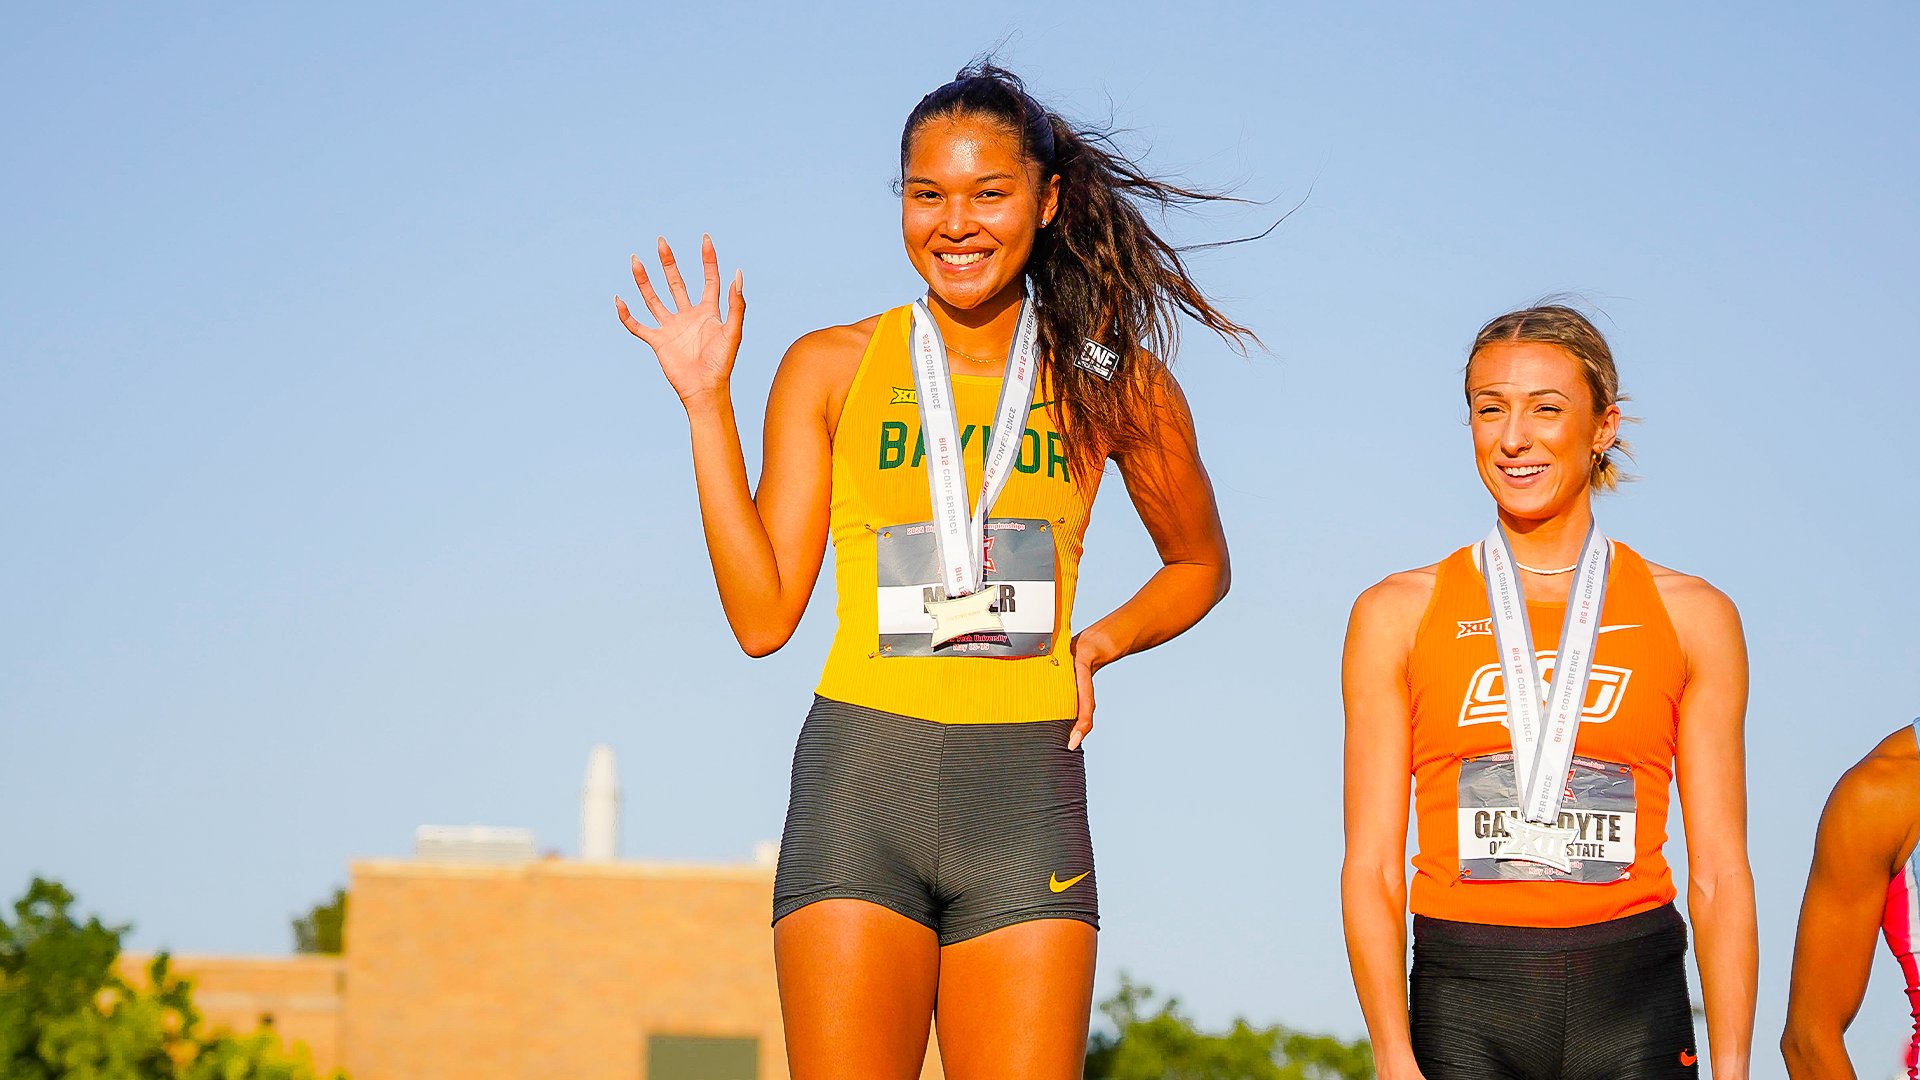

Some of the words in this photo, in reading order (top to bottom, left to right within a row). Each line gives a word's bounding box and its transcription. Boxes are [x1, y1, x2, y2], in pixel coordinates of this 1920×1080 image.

[1021, 307, 1036, 356] CONFERENC
[1019, 355, 1027, 366] 12
[925, 354, 941, 409] CONFERENCE
[1017, 366, 1025, 381] BIG
[939, 437, 948, 453] BIG
[987, 467, 996, 479] 12
[993, 406, 1017, 467] CONFERENCE
[940, 455, 949, 466] 12
[943, 468, 958, 535] CONFERENCE
[1492, 547, 1501, 562] BIG
[954, 566, 963, 583] BIG
[1496, 562, 1504, 572] 12
[1584, 548, 1600, 600] CONFERENCE
[1498, 572, 1513, 620] CONFERENCE
[1582, 600, 1590, 610] 12
[1579, 611, 1588, 624] BIG
[1512, 647, 1521, 662] BIG
[1514, 664, 1523, 675] 12
[1561, 649, 1581, 711] CONFERENCE
[1517, 677, 1533, 743] CONFERENCE
[1557, 713, 1567, 725] 12
[1554, 726, 1563, 743] BIG
[1537, 774, 1553, 821] FERENCE
[1475, 811, 1621, 842] GADYTE
[1567, 843, 1605, 858] STATE
